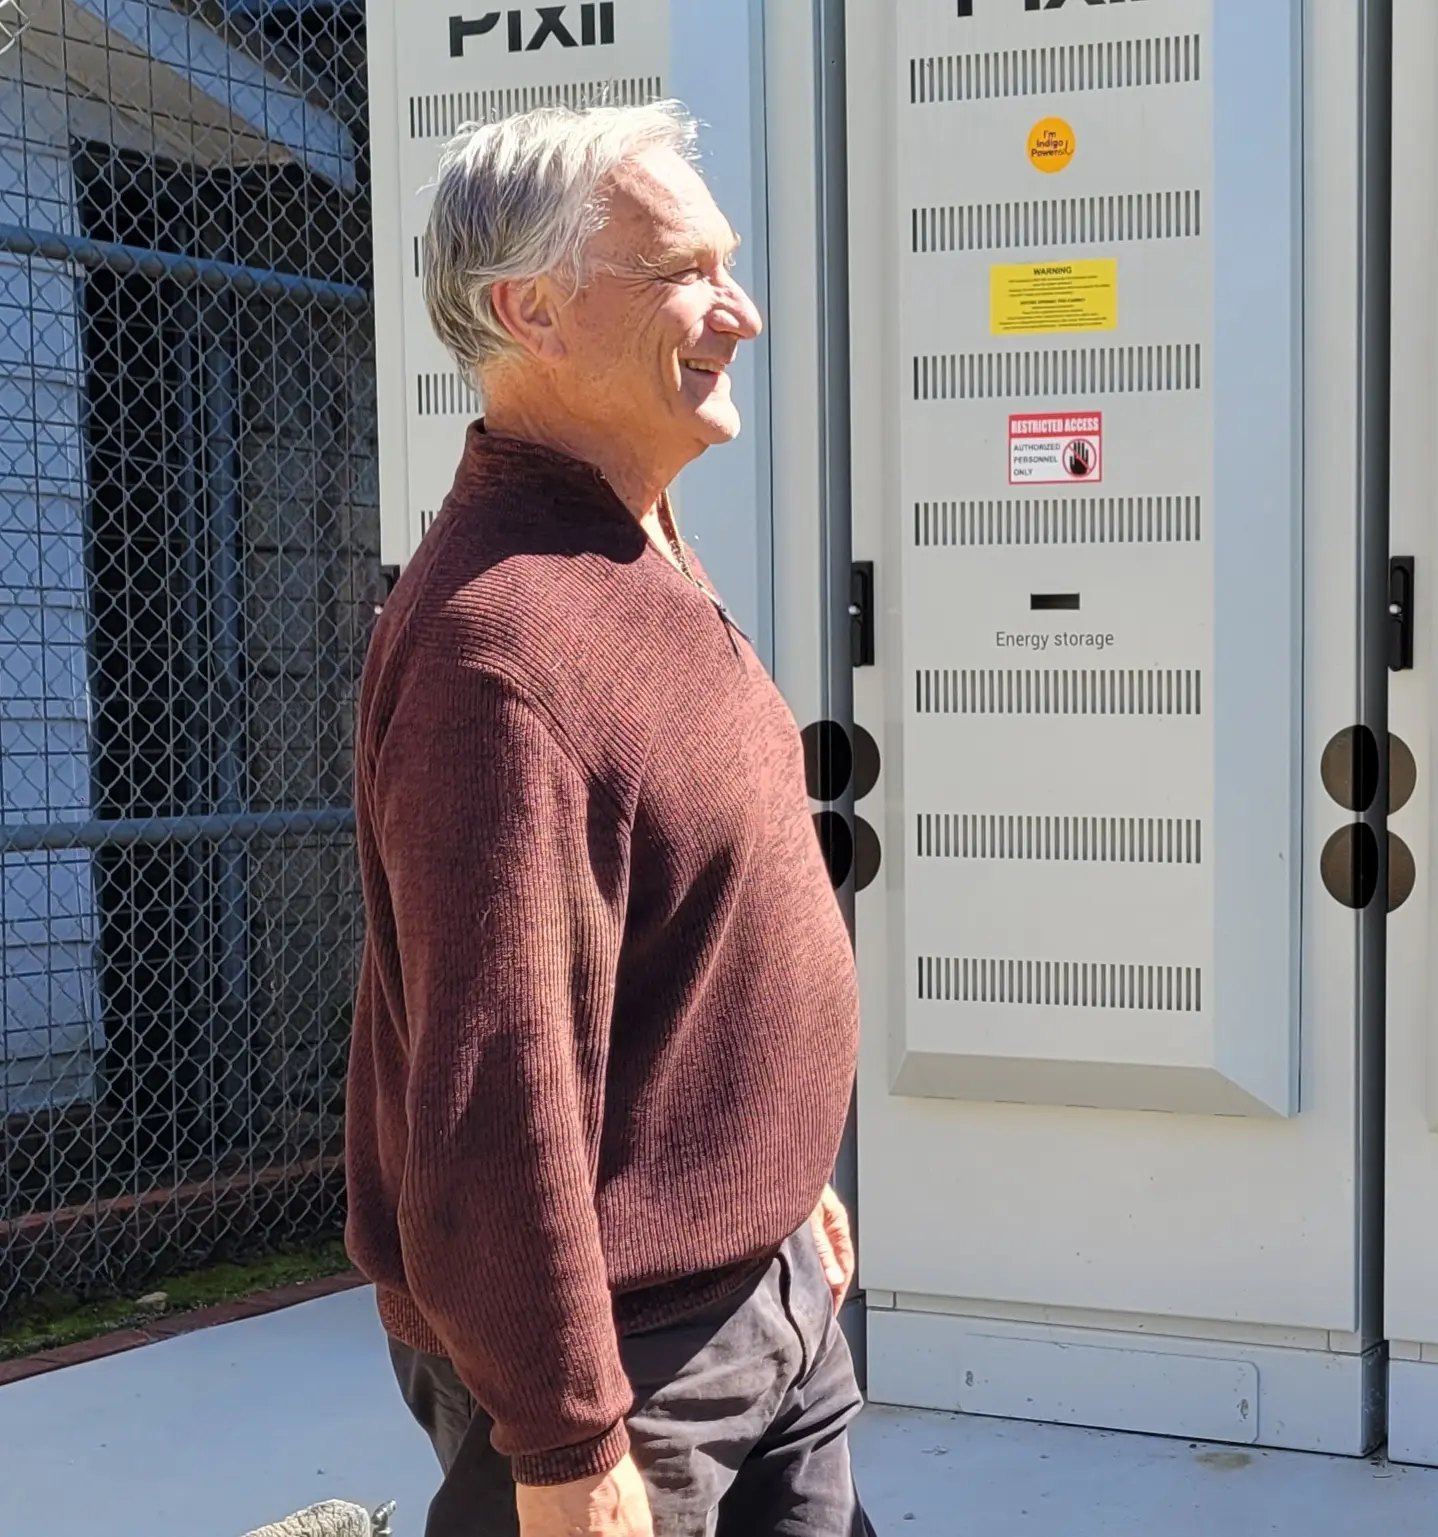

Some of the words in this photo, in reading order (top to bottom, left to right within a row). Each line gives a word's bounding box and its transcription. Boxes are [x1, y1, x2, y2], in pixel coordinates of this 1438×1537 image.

[1036, 138, 1064, 149] Indigo
[1033, 266, 1072, 275] WARNING
[1011, 418, 1063, 434] RESTRICTED
[1064, 417, 1099, 432] ACCESS
[1013, 442, 1061, 452] AUTHORIZED
[1013, 455, 1058, 464] PERSONNEL
[1013, 468, 1033, 477] ONLY
[996, 631, 1050, 651] Energy
[1054, 631, 1115, 651] storage
